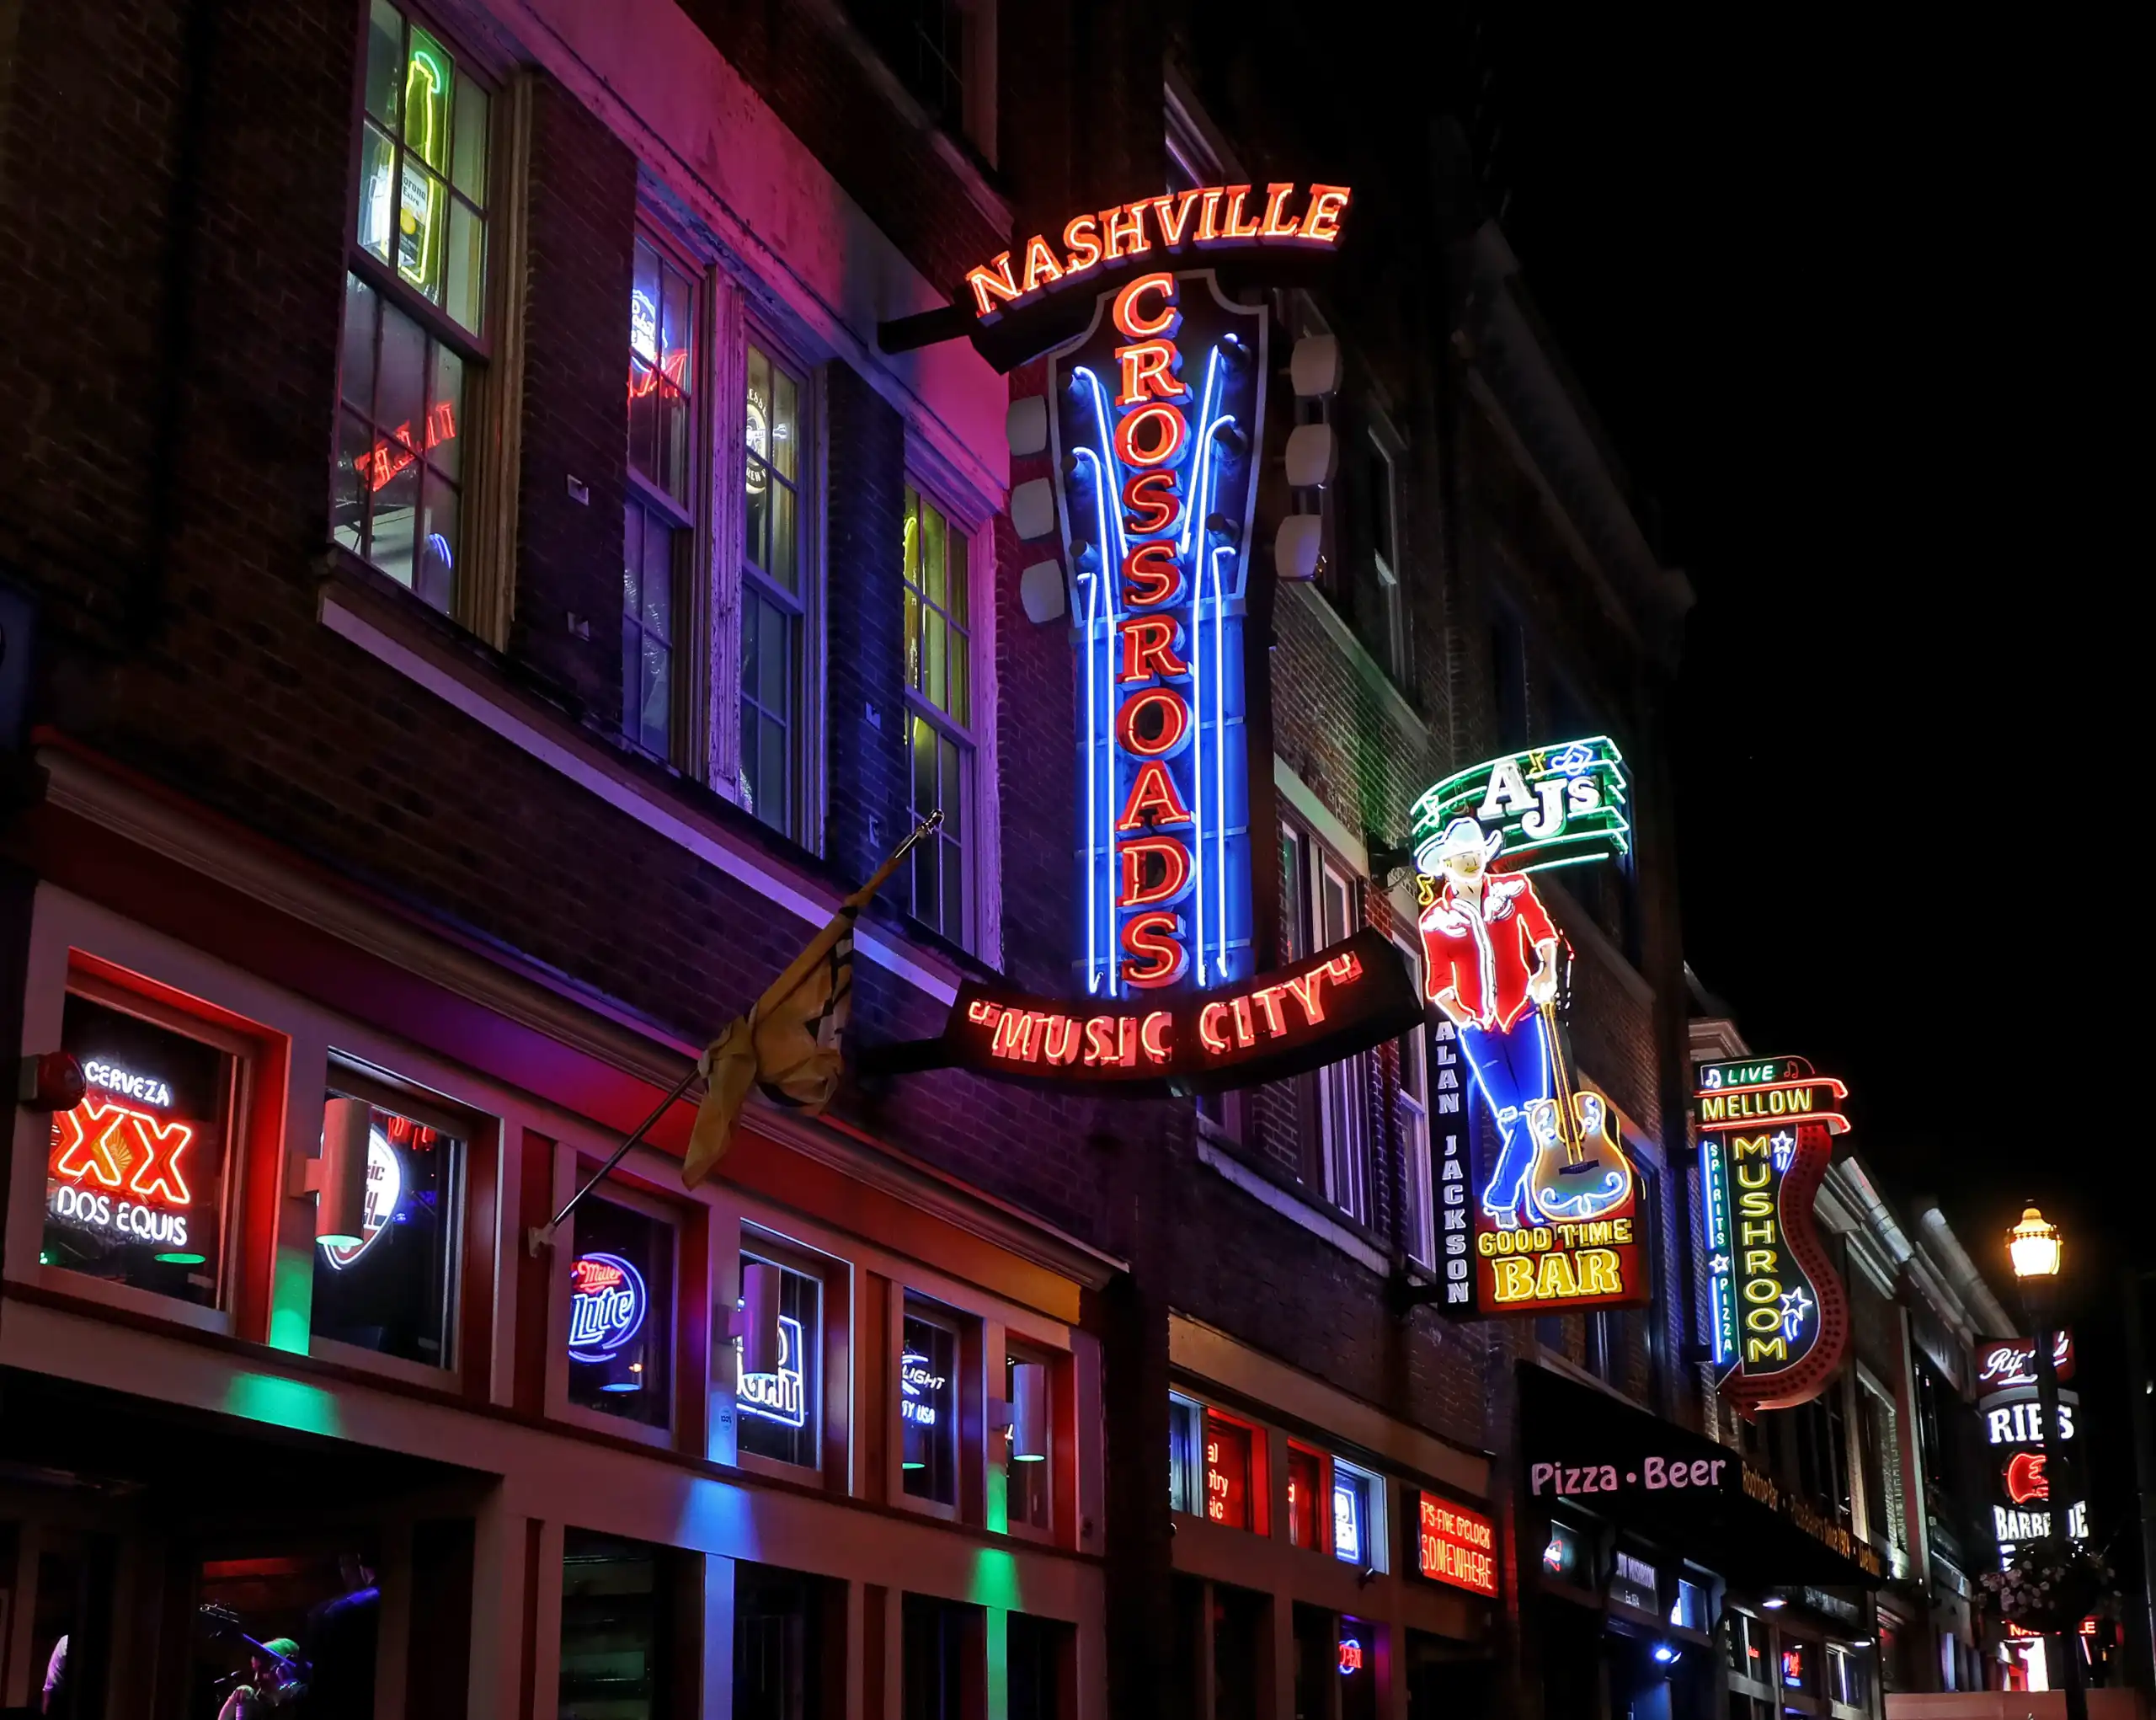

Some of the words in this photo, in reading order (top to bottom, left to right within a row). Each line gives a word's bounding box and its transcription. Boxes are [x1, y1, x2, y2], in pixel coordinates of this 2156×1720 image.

[403, 174, 426, 200] orona
[965, 182, 1351, 318] NASHVILLE
[1112, 271, 1191, 984] CROSSROADS
[84, 1061, 170, 1107] CERVEZA
[1435, 1020, 1460, 1114] ALAN
[1727, 1065, 1774, 1084] LIVE
[1701, 1087, 1813, 1122] MELLOW
[56, 1097, 192, 1205] XX
[57, 1185, 110, 1226] DOS
[116, 1201, 188, 1247] EQUIS
[1441, 1135, 1469, 1304] JACKSON
[1709, 1143, 1726, 1247] SPIRITS
[1478, 1228, 1552, 1256] GOOD
[1556, 1218, 1633, 1249] TIME
[1732, 1135, 1788, 1364] MUSHROOM
[575, 1260, 622, 1283] Miller
[1492, 1248, 1622, 1302] BAR
[568, 1286, 634, 1346] Lite
[1719, 1278, 1733, 1352] PIZZA
[902, 1364, 946, 1390] LIGHT
[916, 1404, 936, 1425] USA
[1531, 1461, 1618, 1496] Pizza
[1644, 1456, 1726, 1490] Beer
[1435, 1509, 1456, 1536] FIVE
[1421, 1533, 1493, 1590] SOMEWHERE
[1339, 1644, 1363, 1669] OPEN
